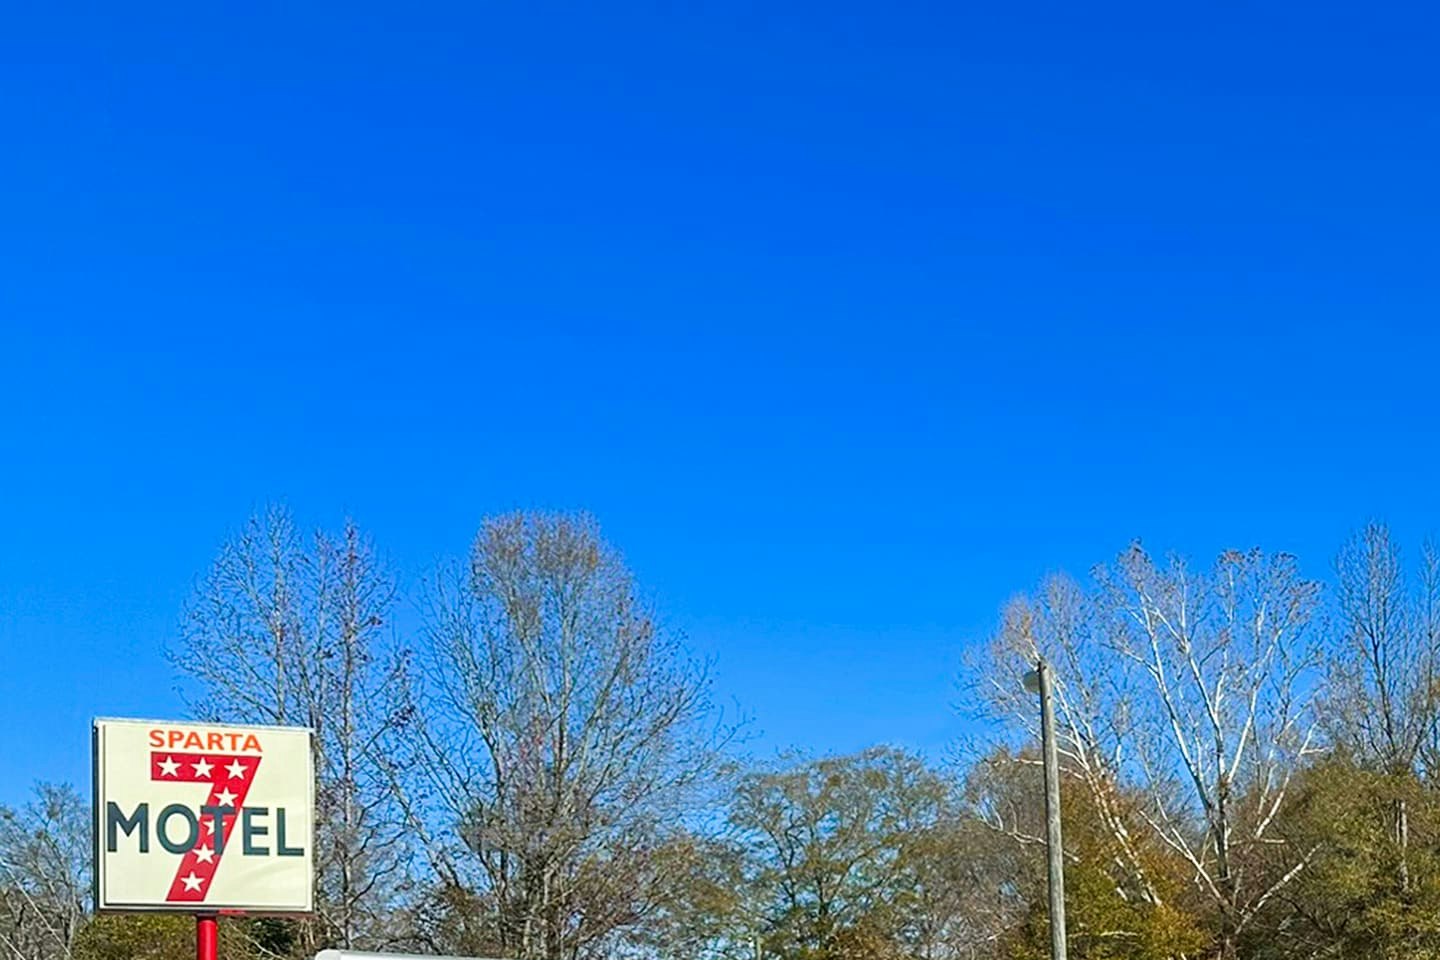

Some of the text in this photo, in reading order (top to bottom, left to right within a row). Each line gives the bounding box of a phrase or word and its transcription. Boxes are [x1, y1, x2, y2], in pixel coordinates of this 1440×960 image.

[149, 729, 262, 752] SPARTA
[107, 801, 304, 856] MOTEL
[150, 751, 262, 902] 7
